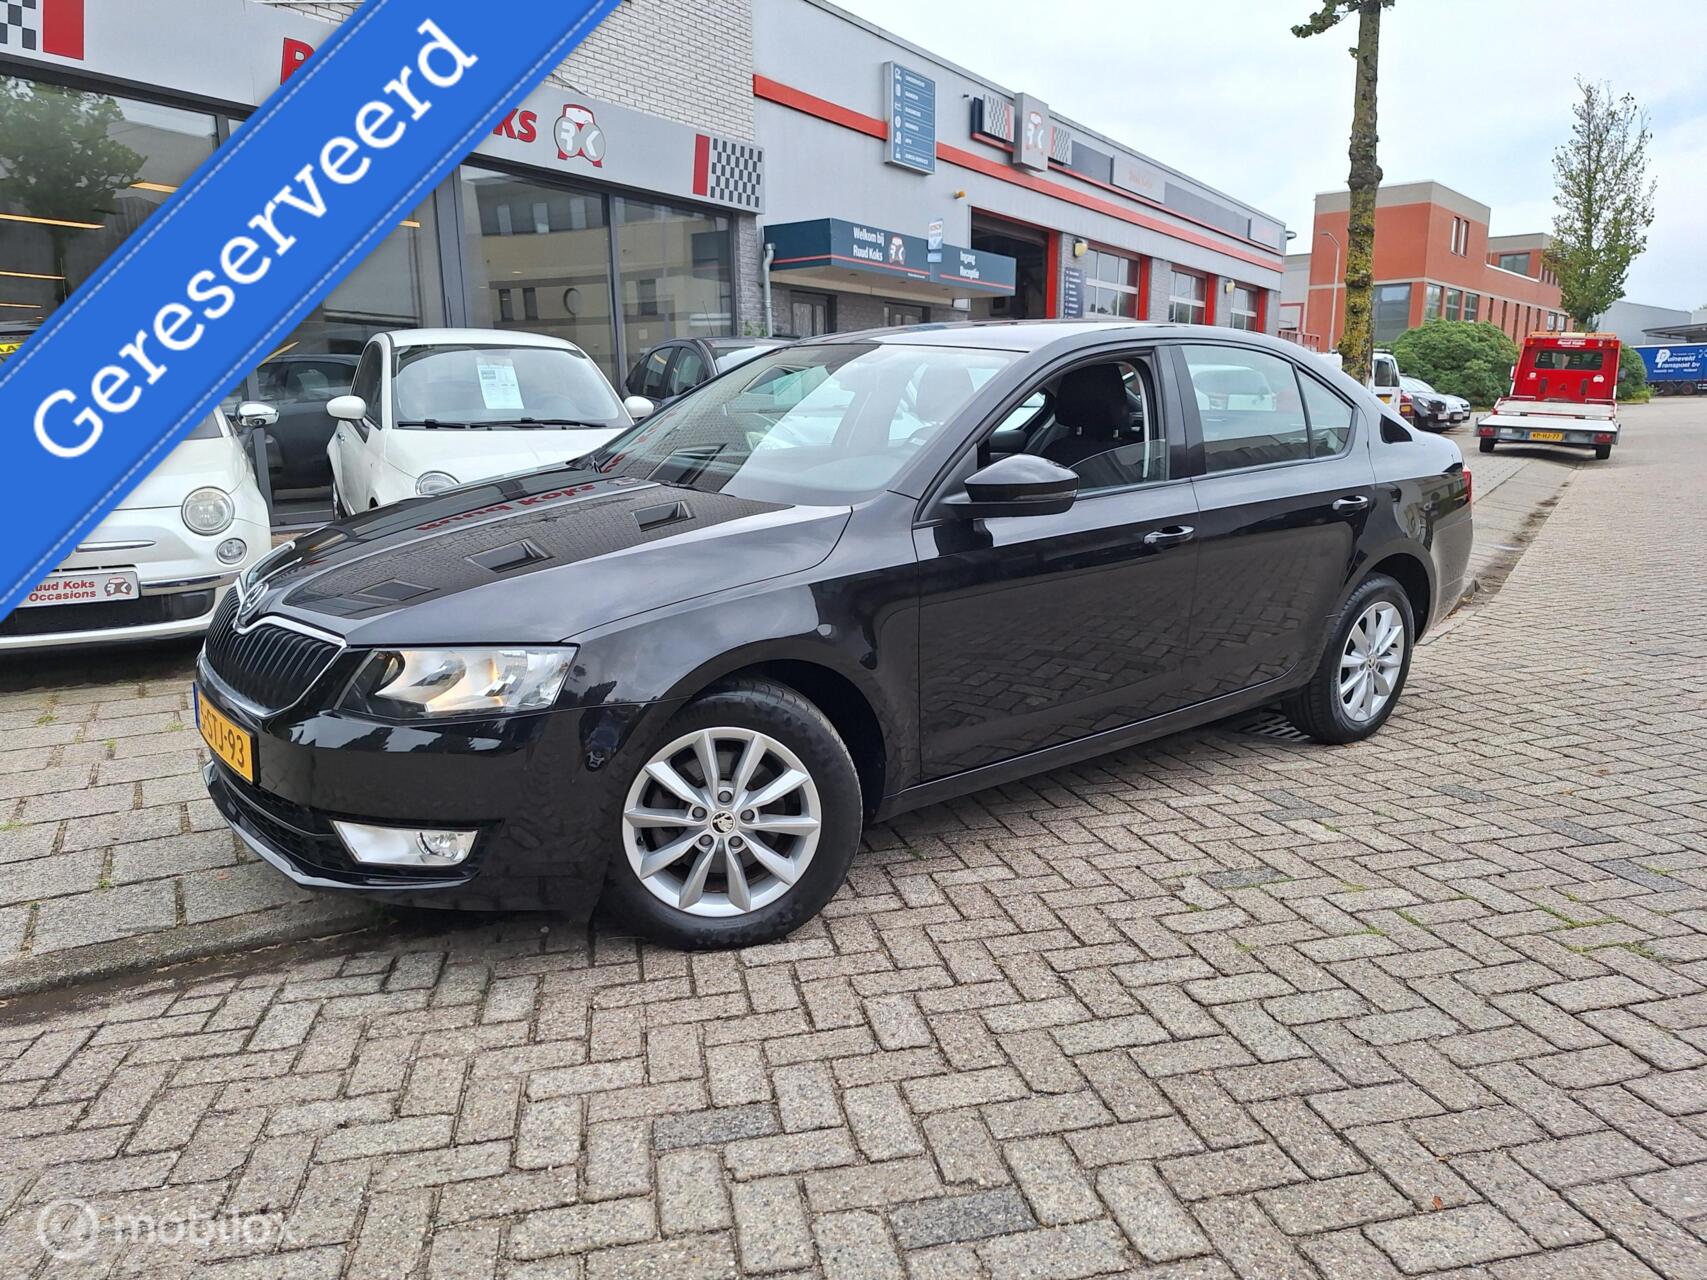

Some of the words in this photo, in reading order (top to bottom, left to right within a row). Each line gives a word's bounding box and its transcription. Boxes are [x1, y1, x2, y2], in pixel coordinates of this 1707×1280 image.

[853, 226, 877, 242] Welkom
[877, 231, 885, 246] bij
[868, 248, 883, 262] Koks
[32, 582, 59, 592] uud
[63, 580, 95, 590] Koks
[28, 590, 97, 602] Occasions
